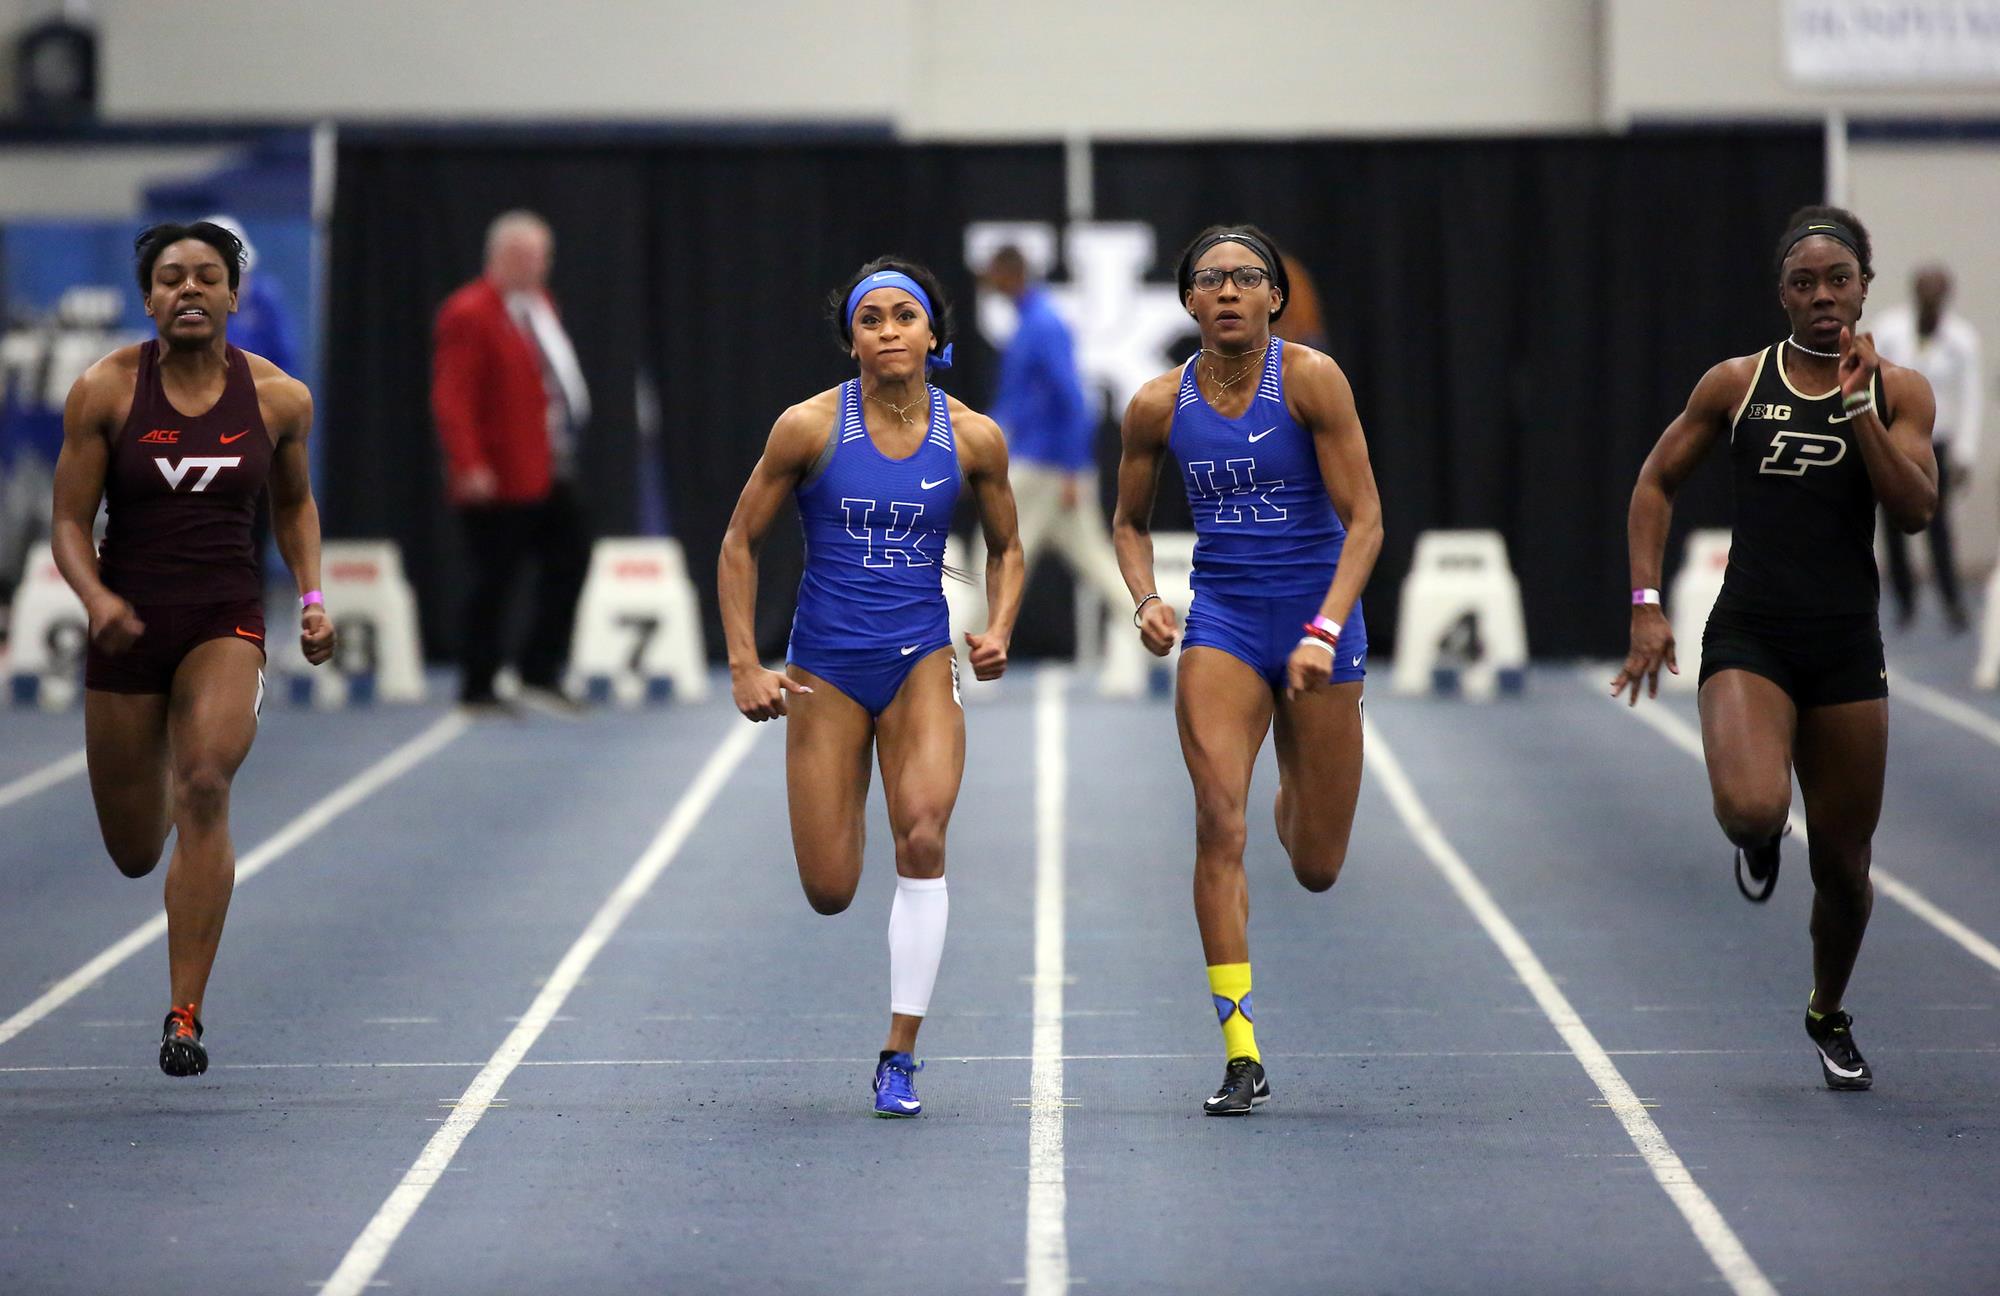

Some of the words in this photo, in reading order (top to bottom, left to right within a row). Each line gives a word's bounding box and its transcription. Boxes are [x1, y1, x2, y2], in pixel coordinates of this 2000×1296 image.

[138, 429, 180, 443] ACC
[1759, 430, 1847, 476] P
[153, 456, 243, 492] VT
[1188, 457, 1287, 523] UK
[841, 497, 937, 568] UK
[613, 612, 662, 675] 7
[1438, 609, 1486, 664] 4
